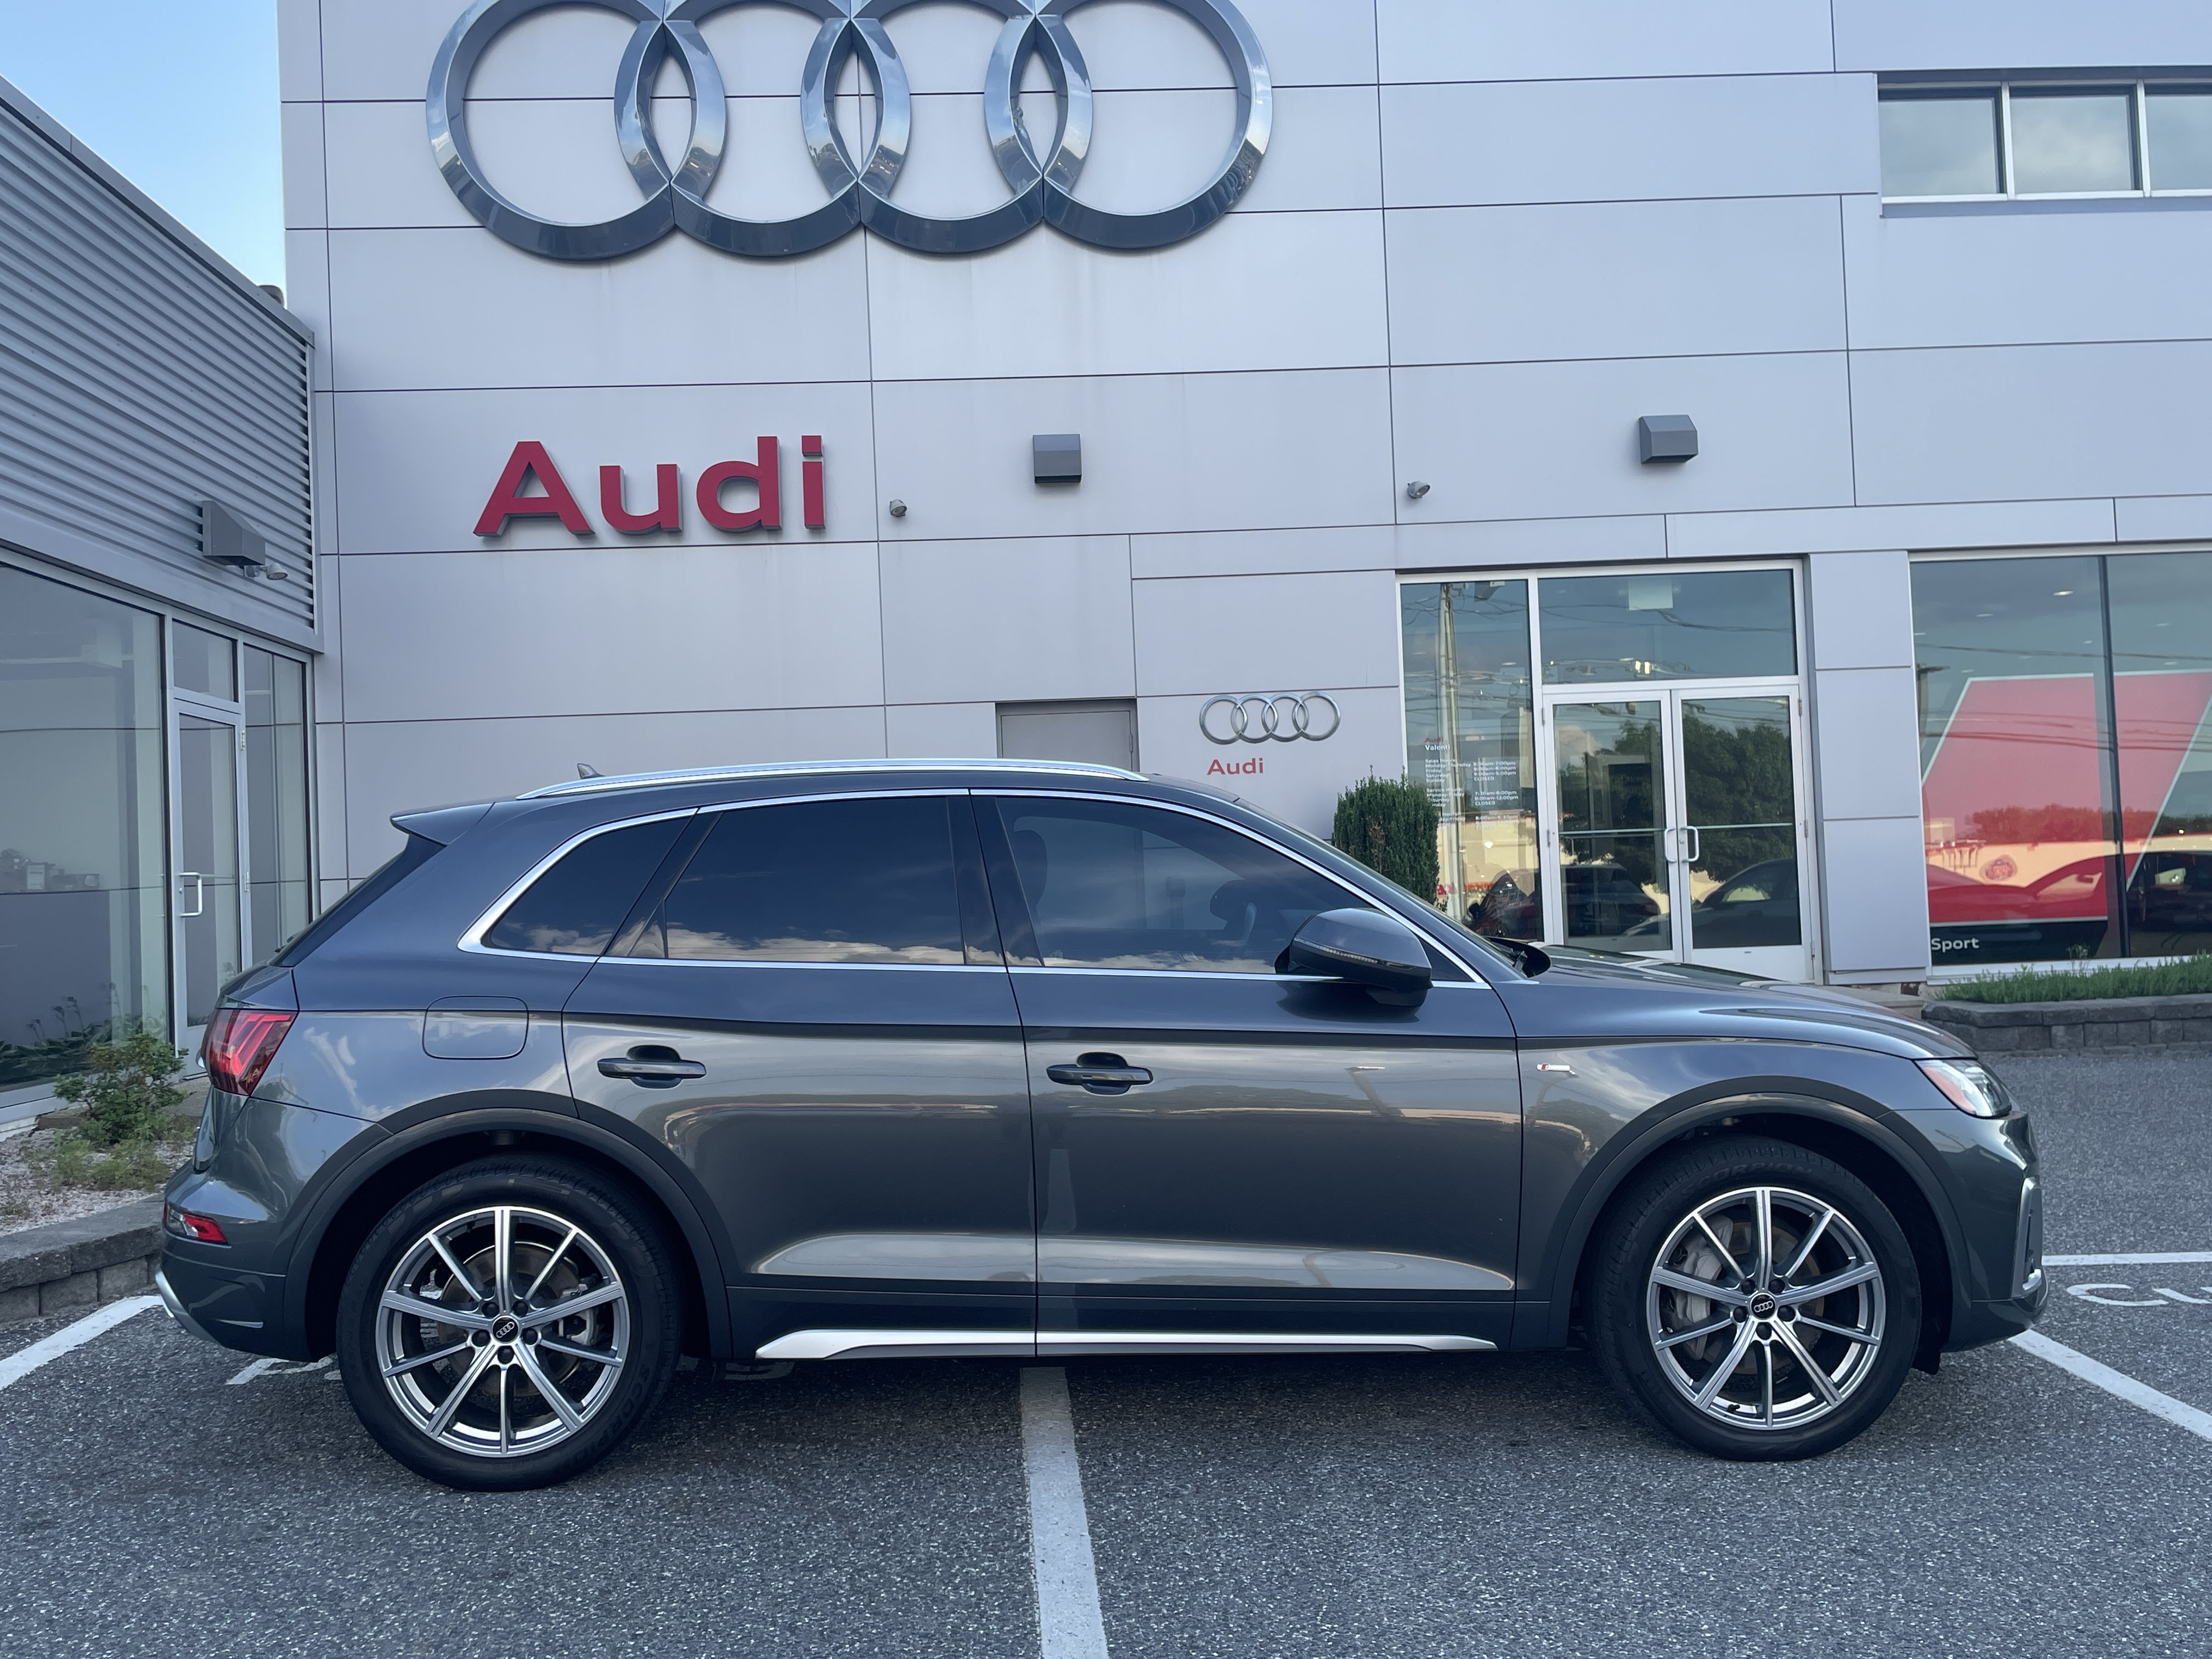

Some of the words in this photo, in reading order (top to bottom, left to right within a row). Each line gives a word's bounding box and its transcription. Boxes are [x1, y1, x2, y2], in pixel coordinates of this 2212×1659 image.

[473, 435, 826, 537] Audi
[1207, 757, 1264, 775] Audi
[1931, 937, 1979, 953] Sport
